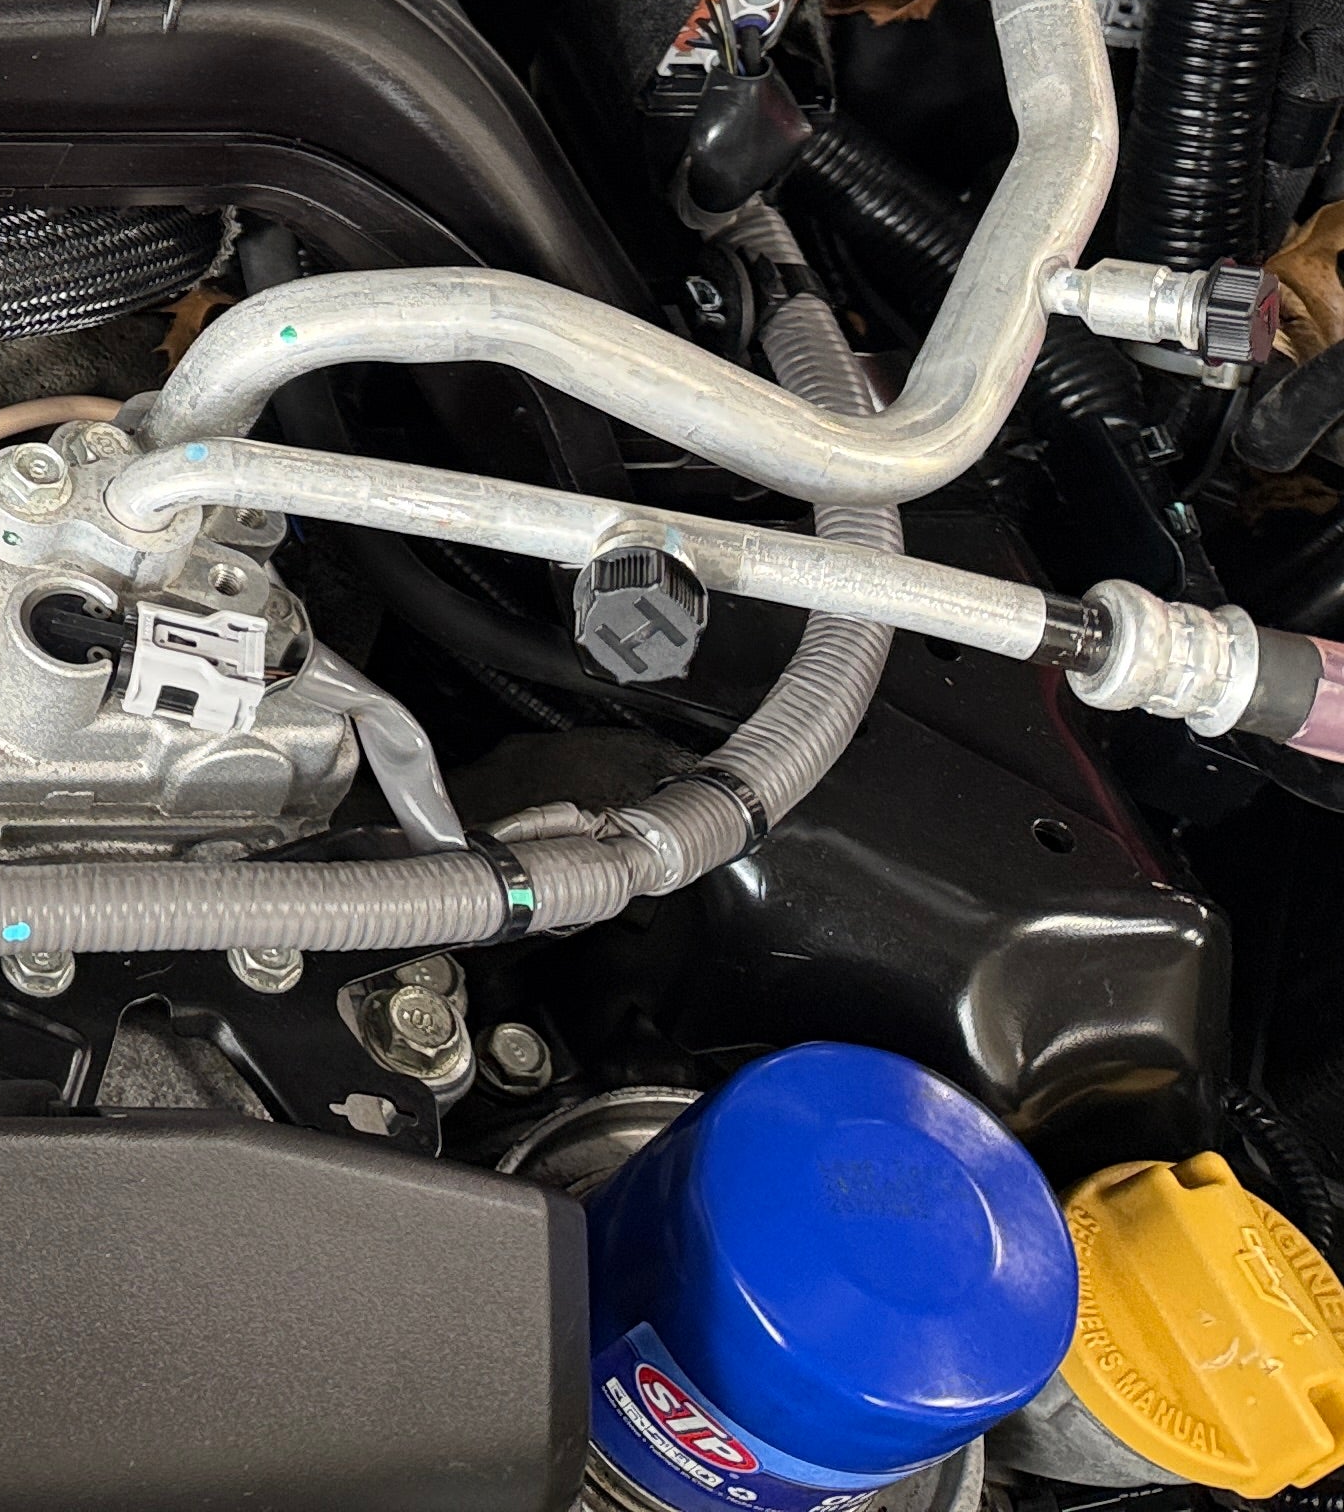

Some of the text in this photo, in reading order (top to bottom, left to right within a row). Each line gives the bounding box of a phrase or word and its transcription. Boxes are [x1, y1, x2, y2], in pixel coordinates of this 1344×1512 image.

[594, 596, 688, 674] H
[642, 1381, 745, 1464] STP
[1116, 1365, 1226, 1459] MANUAL
